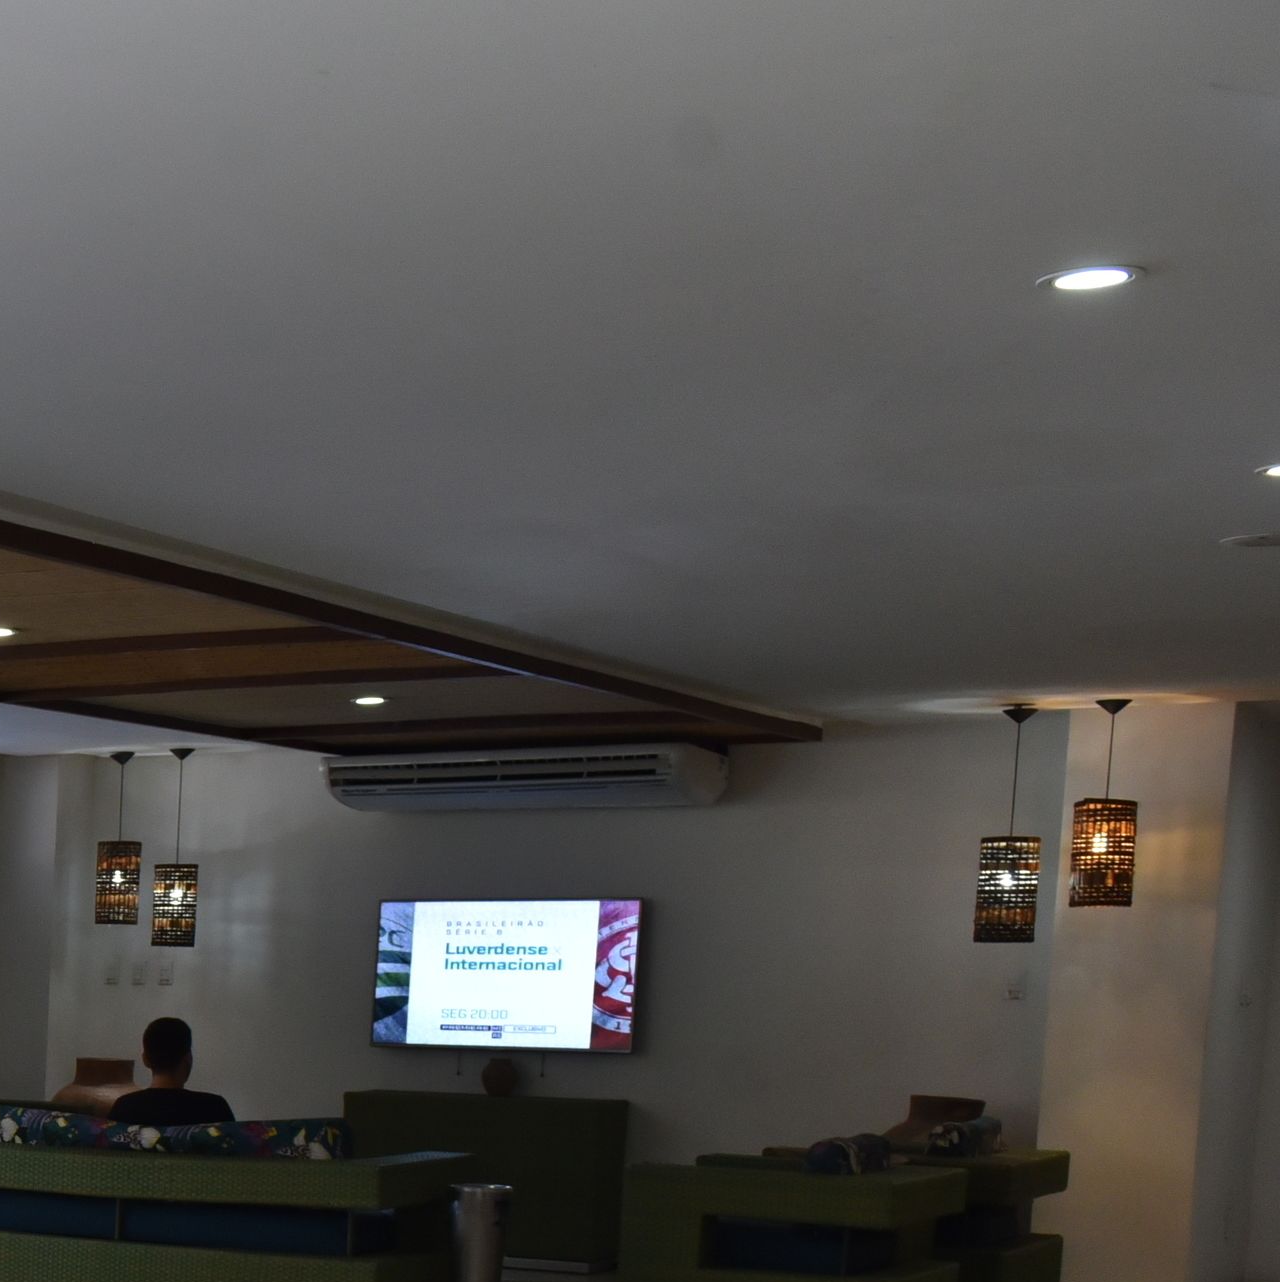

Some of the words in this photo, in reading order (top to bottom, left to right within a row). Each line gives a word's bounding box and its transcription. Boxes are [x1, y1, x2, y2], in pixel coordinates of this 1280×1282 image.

[444, 943, 549, 955] Luverdense
[444, 958, 563, 971] Internacional
[441, 1008, 467, 1019] SEG
[470, 1009, 509, 1019] 20:00
